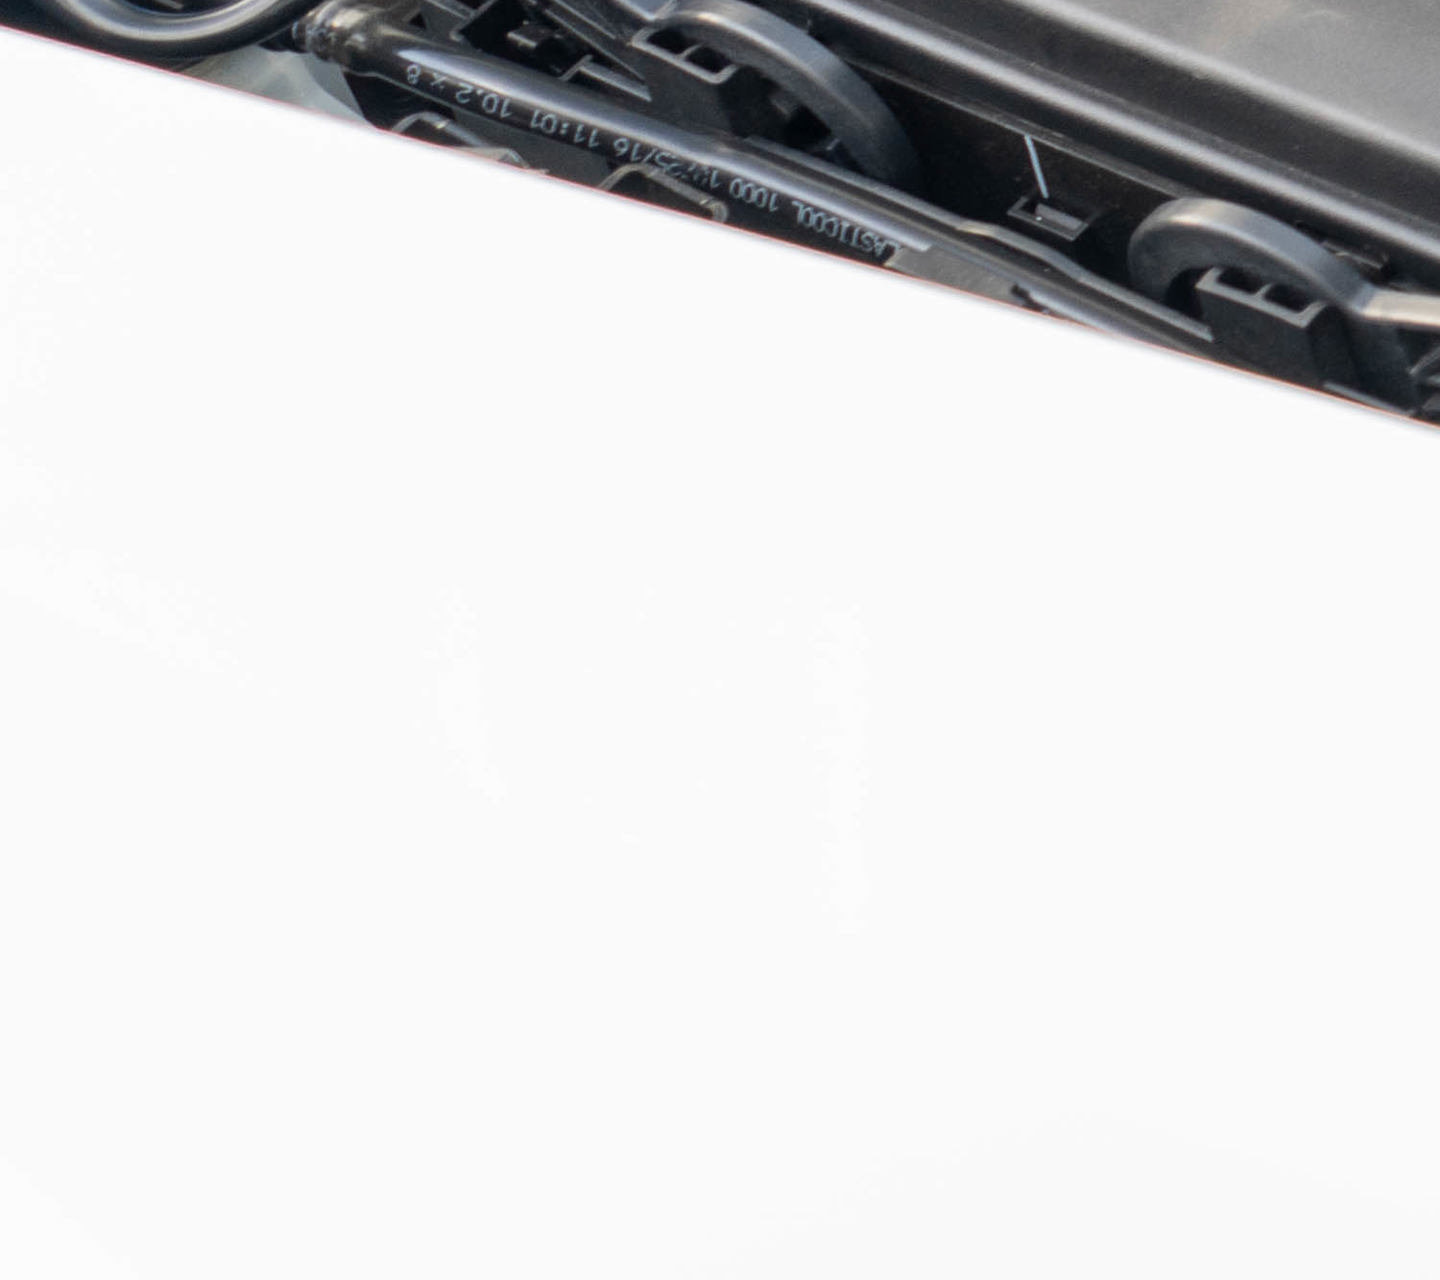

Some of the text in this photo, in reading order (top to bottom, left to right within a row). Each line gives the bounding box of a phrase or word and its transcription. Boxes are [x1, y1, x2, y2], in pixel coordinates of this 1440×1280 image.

[406, 63, 419, 85] 8
[455, 82, 513, 118] 10.2
[530, 108, 600, 148] 11:01
[729, 177, 780, 213] 1000
